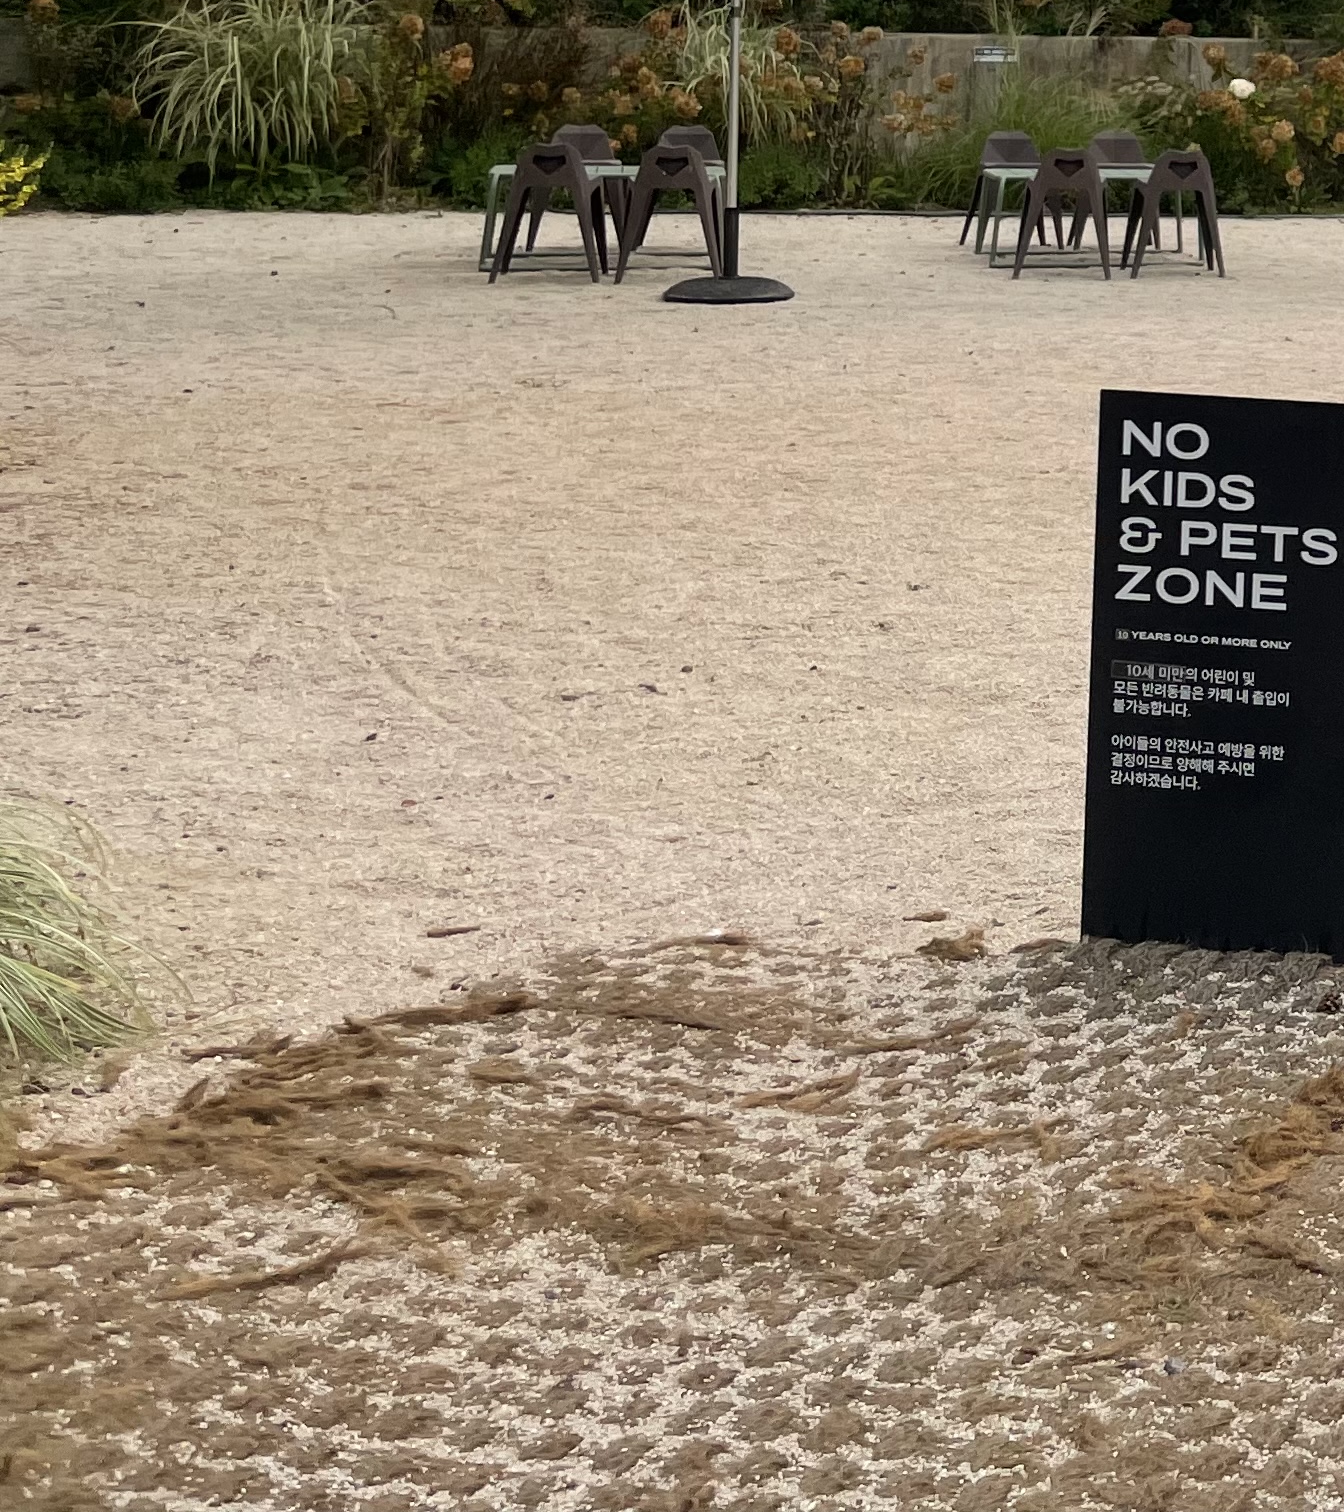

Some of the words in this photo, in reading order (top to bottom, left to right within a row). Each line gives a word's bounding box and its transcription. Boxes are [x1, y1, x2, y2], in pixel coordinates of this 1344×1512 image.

[1121, 419, 1210, 460] NO
[1120, 468, 1256, 512] KIDS
[1119, 516, 1163, 554] &
[1180, 520, 1339, 566] PETS
[1114, 563, 1288, 611] ZONE
[1118, 630, 1129, 640] 10
[1131, 630, 1172, 642] YEARS
[1173, 633, 1199, 644] OLD
[1201, 635, 1219, 645] OR
[1221, 637, 1258, 648] MORE
[1260, 639, 1293, 650] ONLY
[1126, 663, 1155, 680] 10세
[1158, 665, 1198, 683] 미만의
[1201, 668, 1239, 686] 어린이
[1242, 671, 1255, 687] 및
[1113, 680, 1139, 696] 모든
[1141, 682, 1205, 701] 반려동물은
[1207, 687, 1233, 703] 카페
[1236, 689, 1249, 704] 내
[1252, 690, 1290, 708] 출입이
[1112, 698, 1192, 718] 불가능합니다.
[1111, 734, 1161, 752] 아이들의
[1164, 737, 1215, 755] 안전사고
[1217, 742, 1256, 759] 예방을
[1258, 745, 1285, 761] 위한
[1111, 751, 1174, 770] 결정이므로
[1176, 757, 1215, 774] 양해해
[1217, 760, 1255, 777] 주시면
[1110, 769, 1201, 791] 감사하겠습니다.
